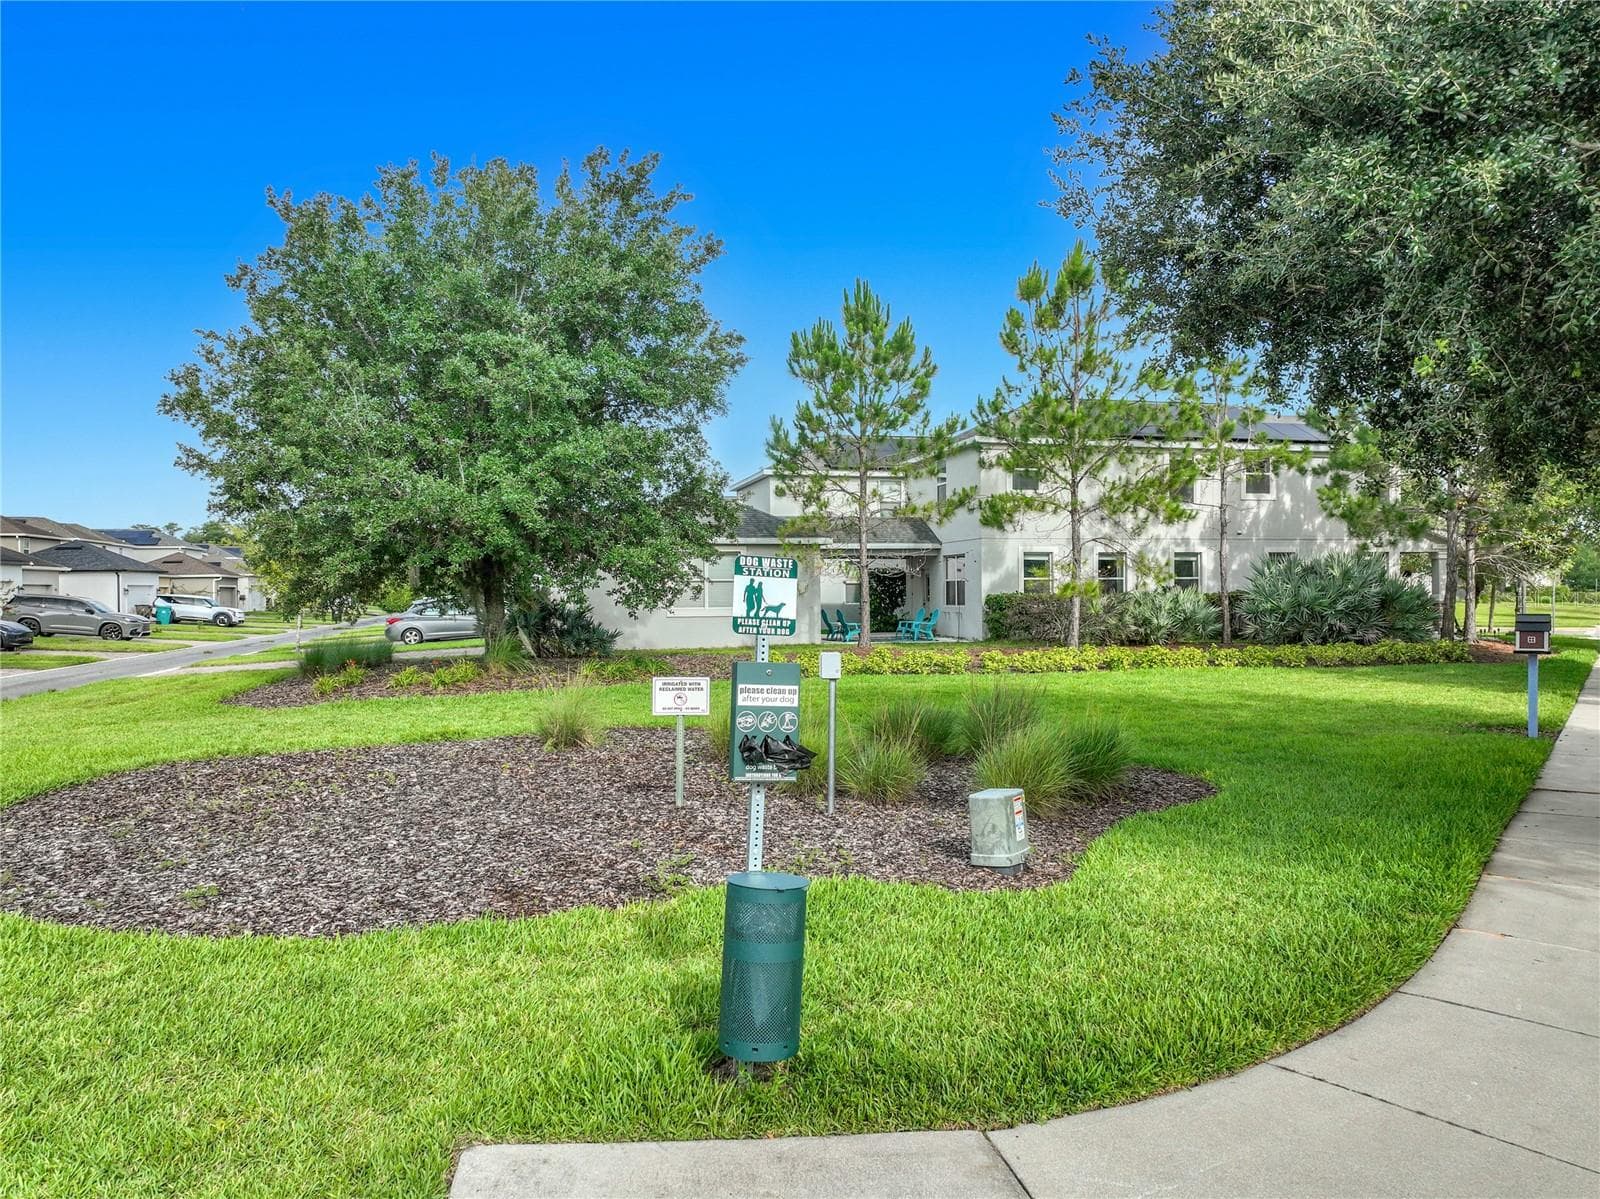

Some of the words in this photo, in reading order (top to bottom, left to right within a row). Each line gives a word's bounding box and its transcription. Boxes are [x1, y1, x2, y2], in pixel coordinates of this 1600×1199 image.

[740, 556, 758, 566] DOG
[762, 558, 793, 568] WASTE
[742, 568, 790, 578] STATION
[740, 686, 765, 695] please
[779, 696, 794, 704] dog
